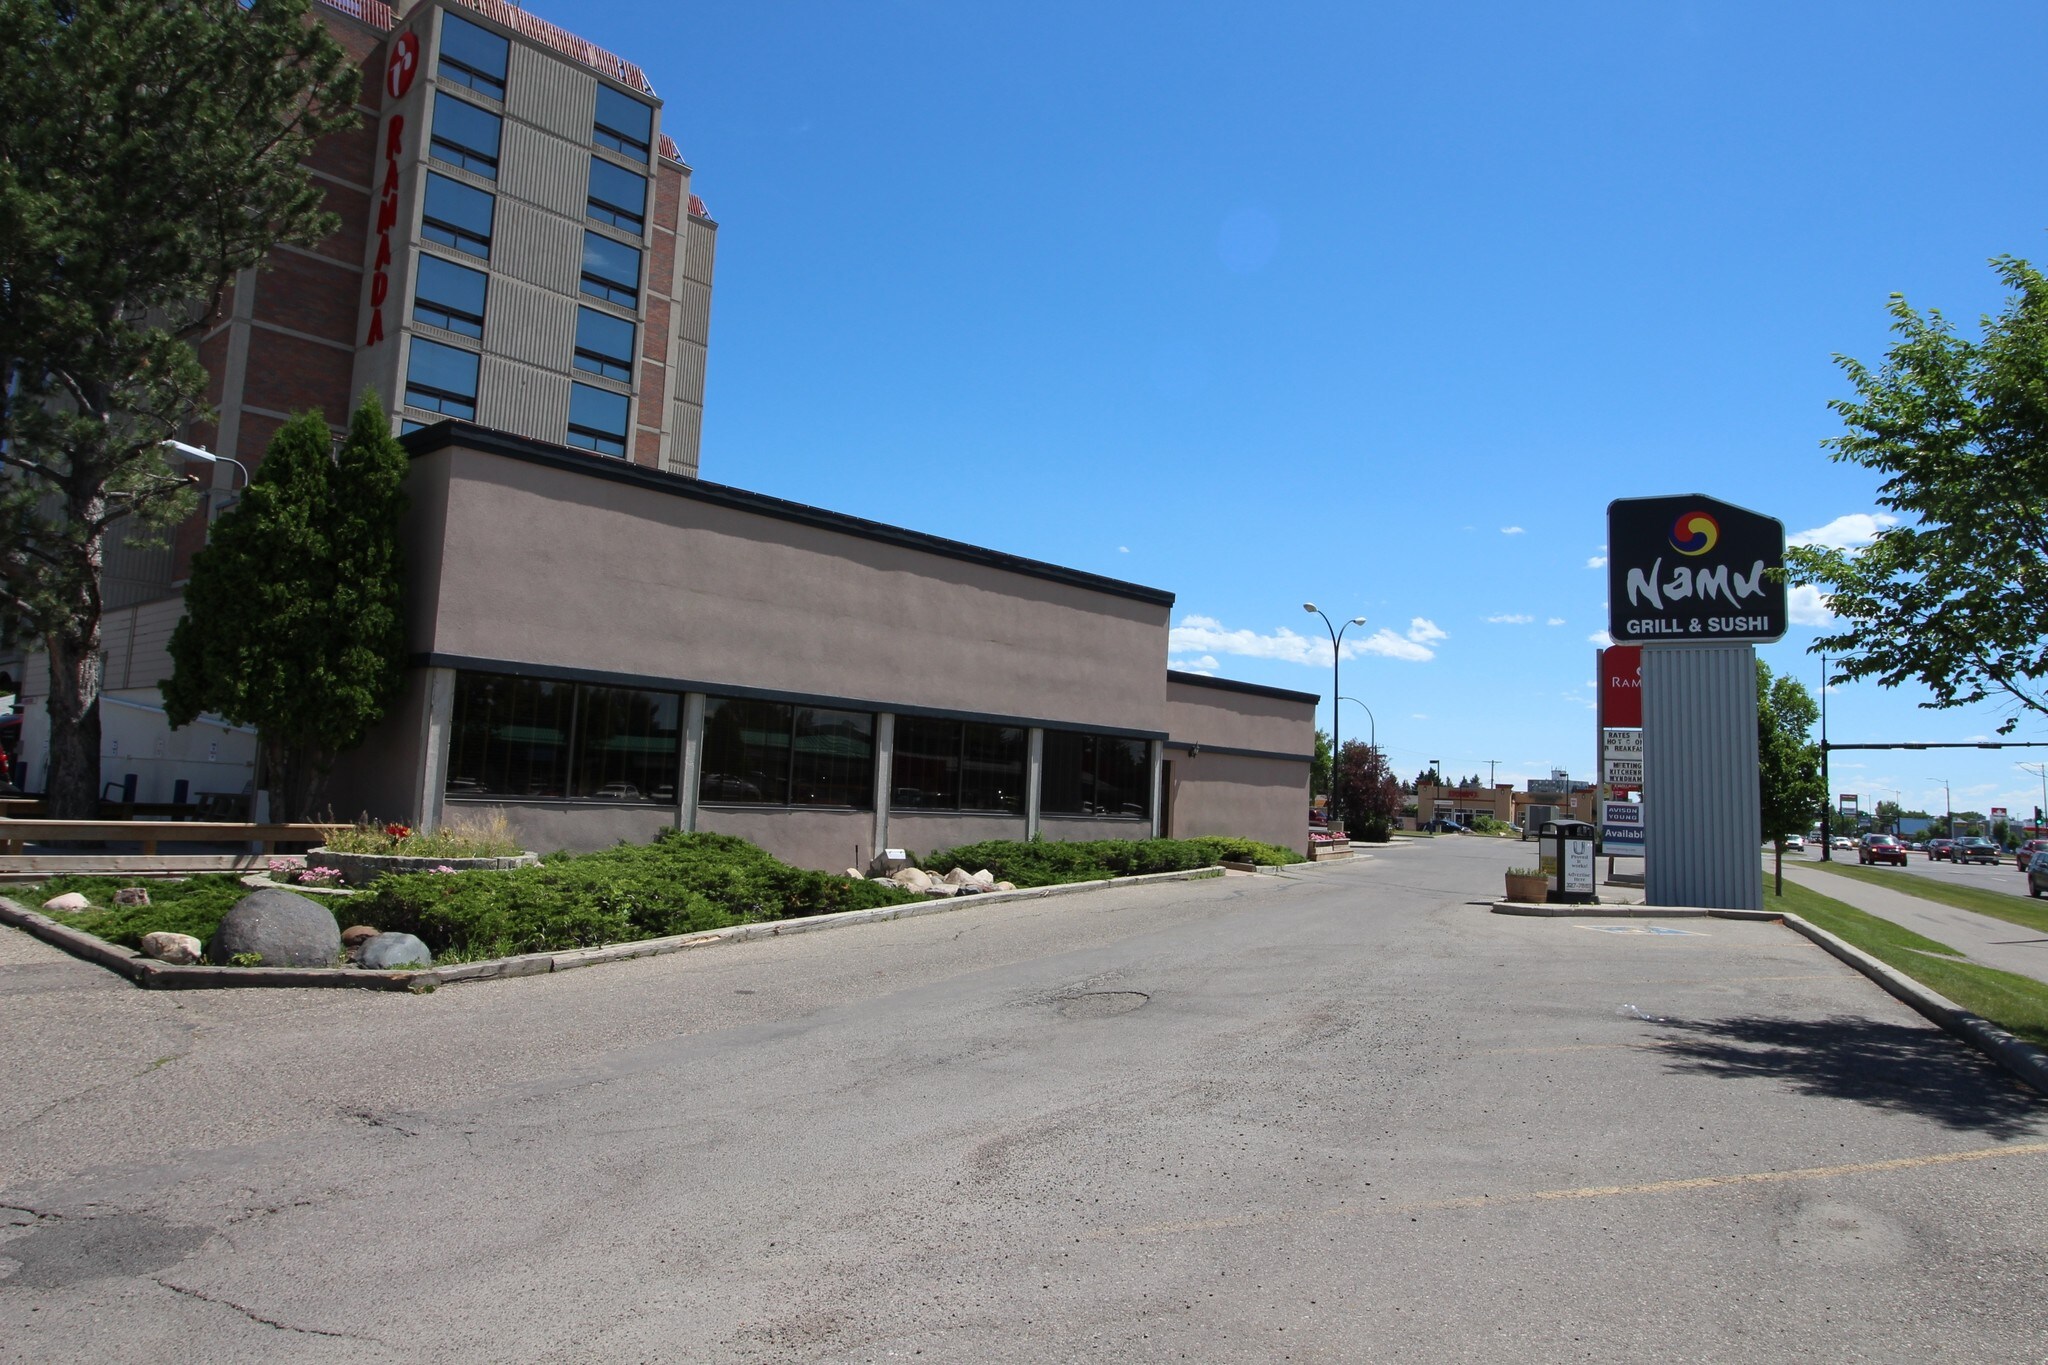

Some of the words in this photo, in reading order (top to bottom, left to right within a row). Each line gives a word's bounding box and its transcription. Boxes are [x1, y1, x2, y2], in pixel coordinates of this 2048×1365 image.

[366, 114, 405, 347] RAMADA
[1626, 616, 1684, 634] GRILL
[1688, 617, 1702, 632] &
[1707, 615, 1769, 632] SUSHI
